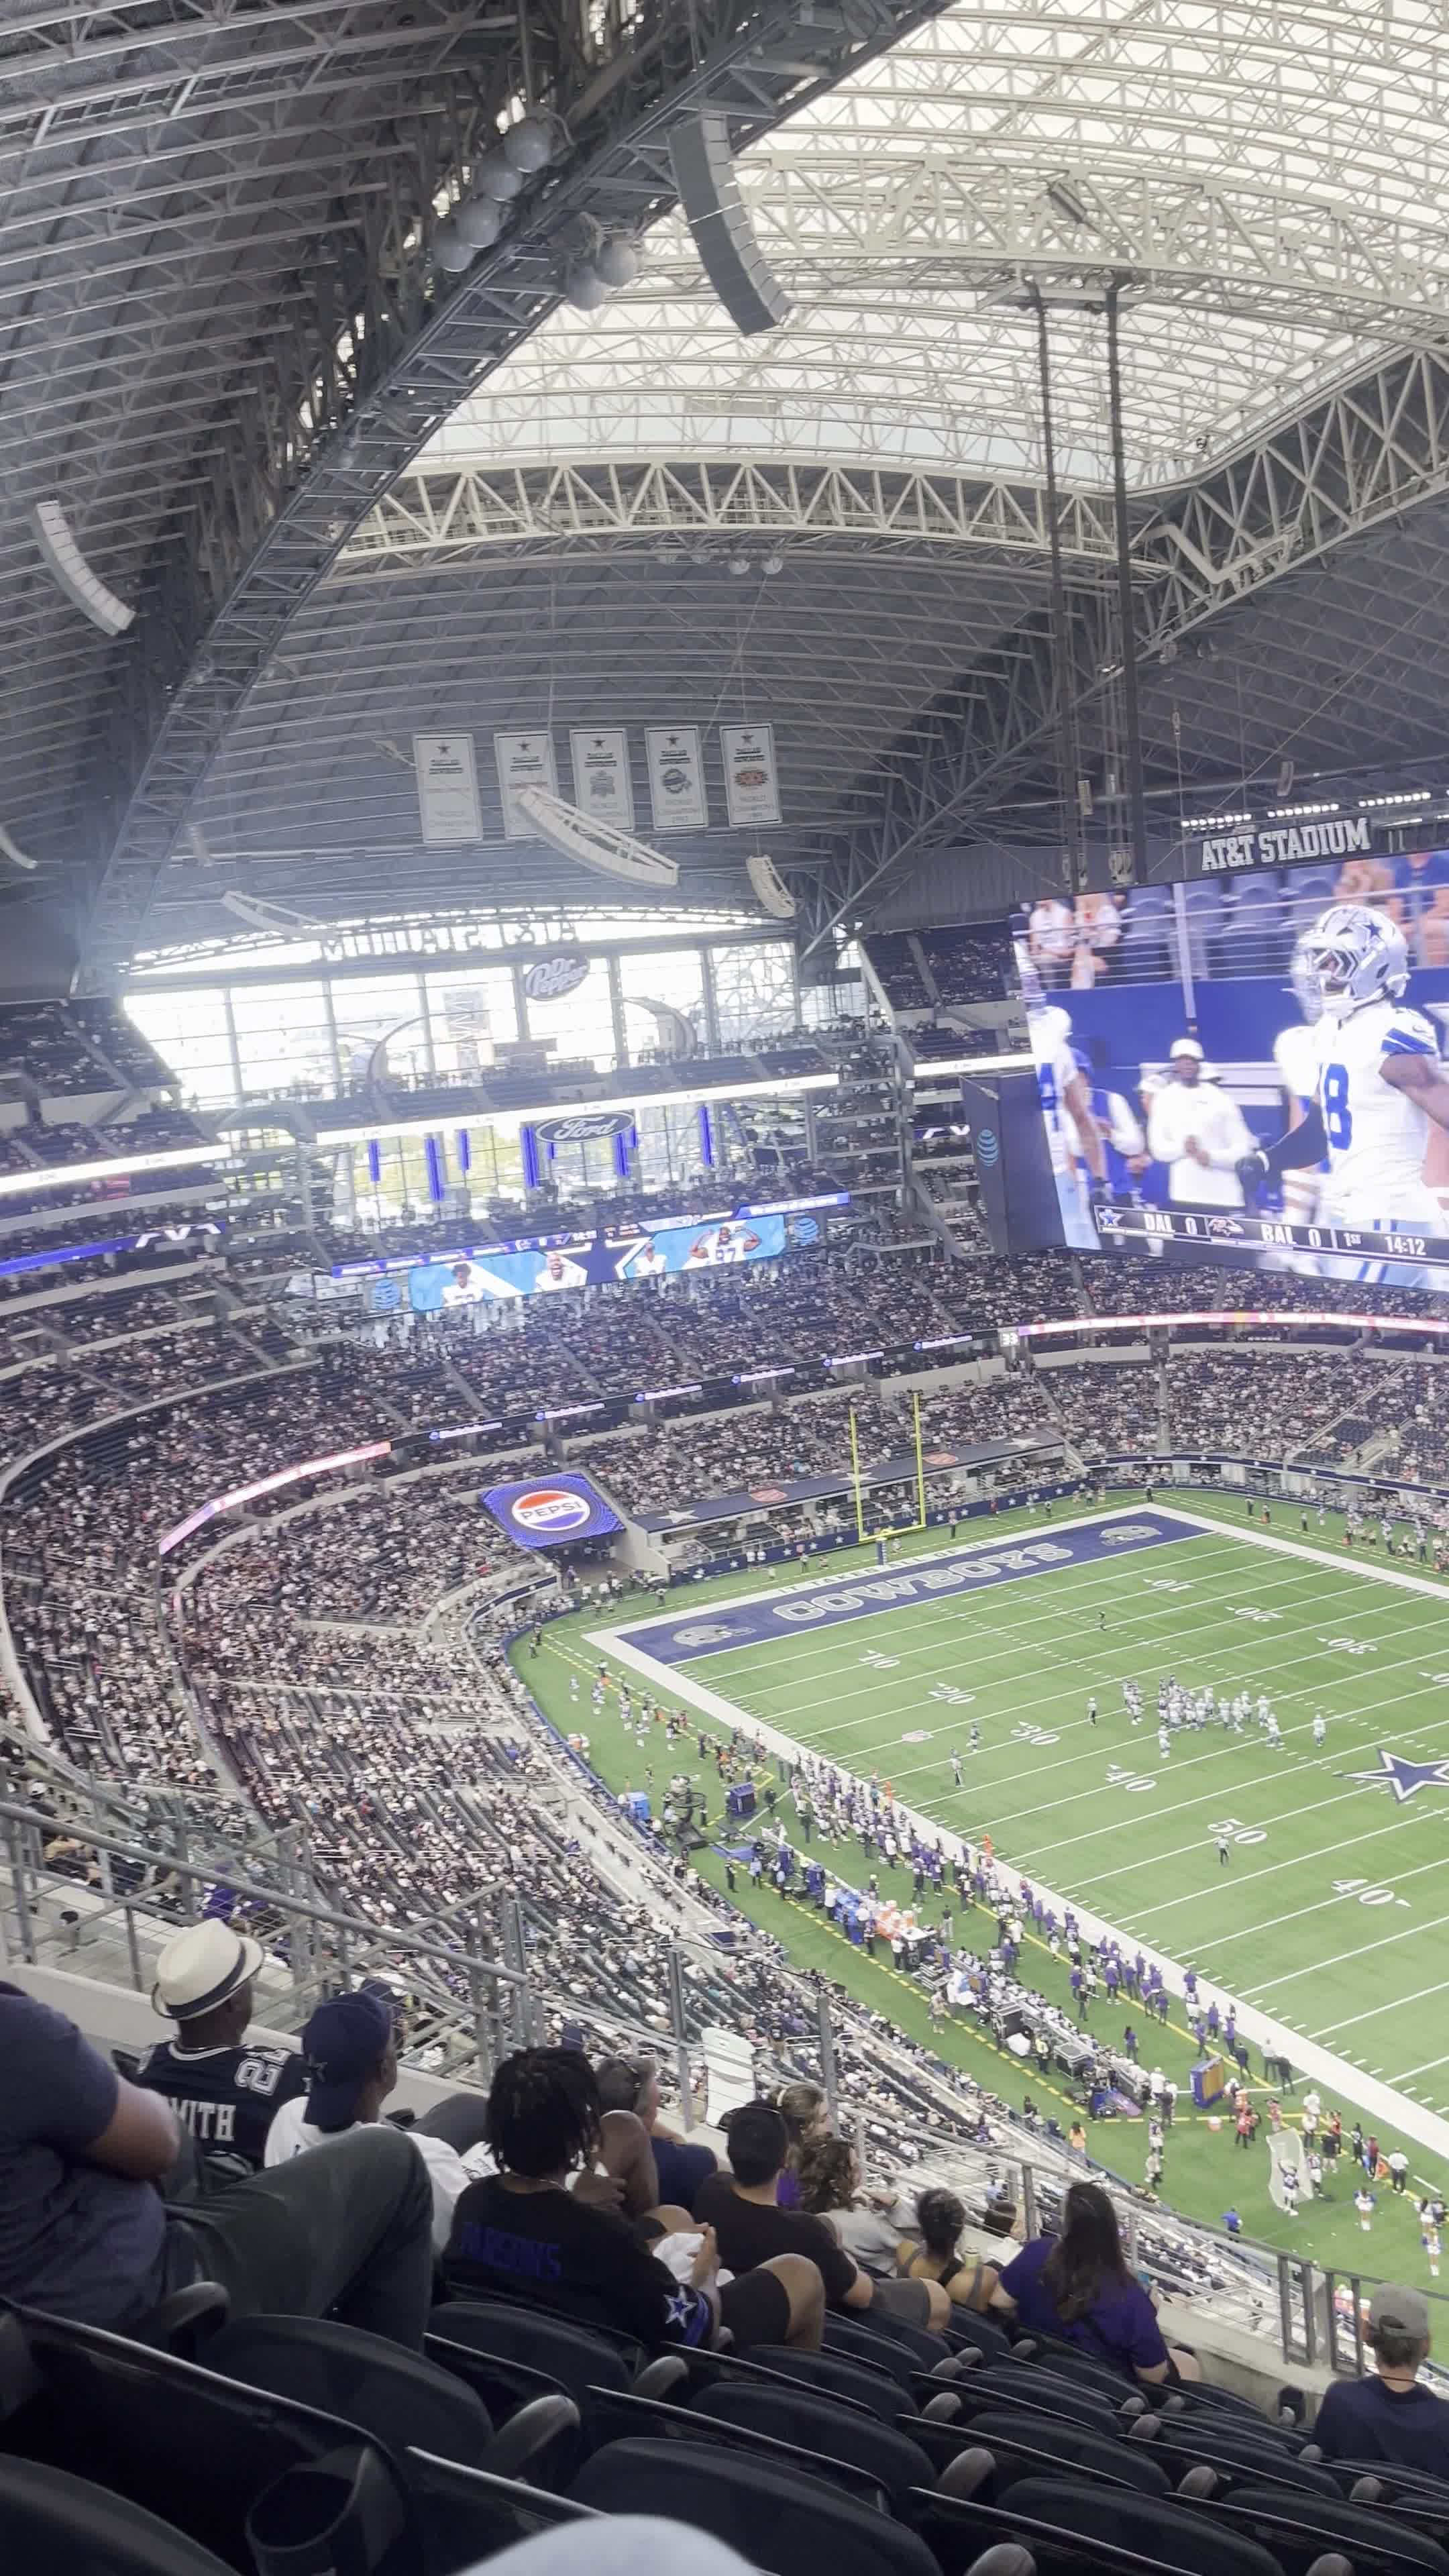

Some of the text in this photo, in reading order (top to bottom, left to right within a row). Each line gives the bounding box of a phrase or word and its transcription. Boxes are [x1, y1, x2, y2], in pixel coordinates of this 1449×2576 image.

[1201, 817, 1371, 871] AT&T STADIUM
[551, 957, 576, 973] Dr
[525, 963, 588, 996] Pepper
[553, 1116, 619, 1140] Ford
[1143, 1213, 1176, 1232] DAL
[1185, 1217, 1197, 1235] 0
[1260, 1224, 1297, 1246] BAL
[1308, 1228, 1322, 1248] 0
[1385, 1236, 1427, 1256] 14:12
[521, 1501, 582, 1519] PEPSI
[772, 1542, 1074, 1621] COWBOYS
[858, 1651, 901, 1669] 10
[928, 1685, 976, 1705] 20
[1010, 1723, 1061, 1746] 30
[1104, 1769, 1157, 1792] 40
[1207, 1818, 1268, 1845] 50
[1330, 1878, 1395, 1906] 40
